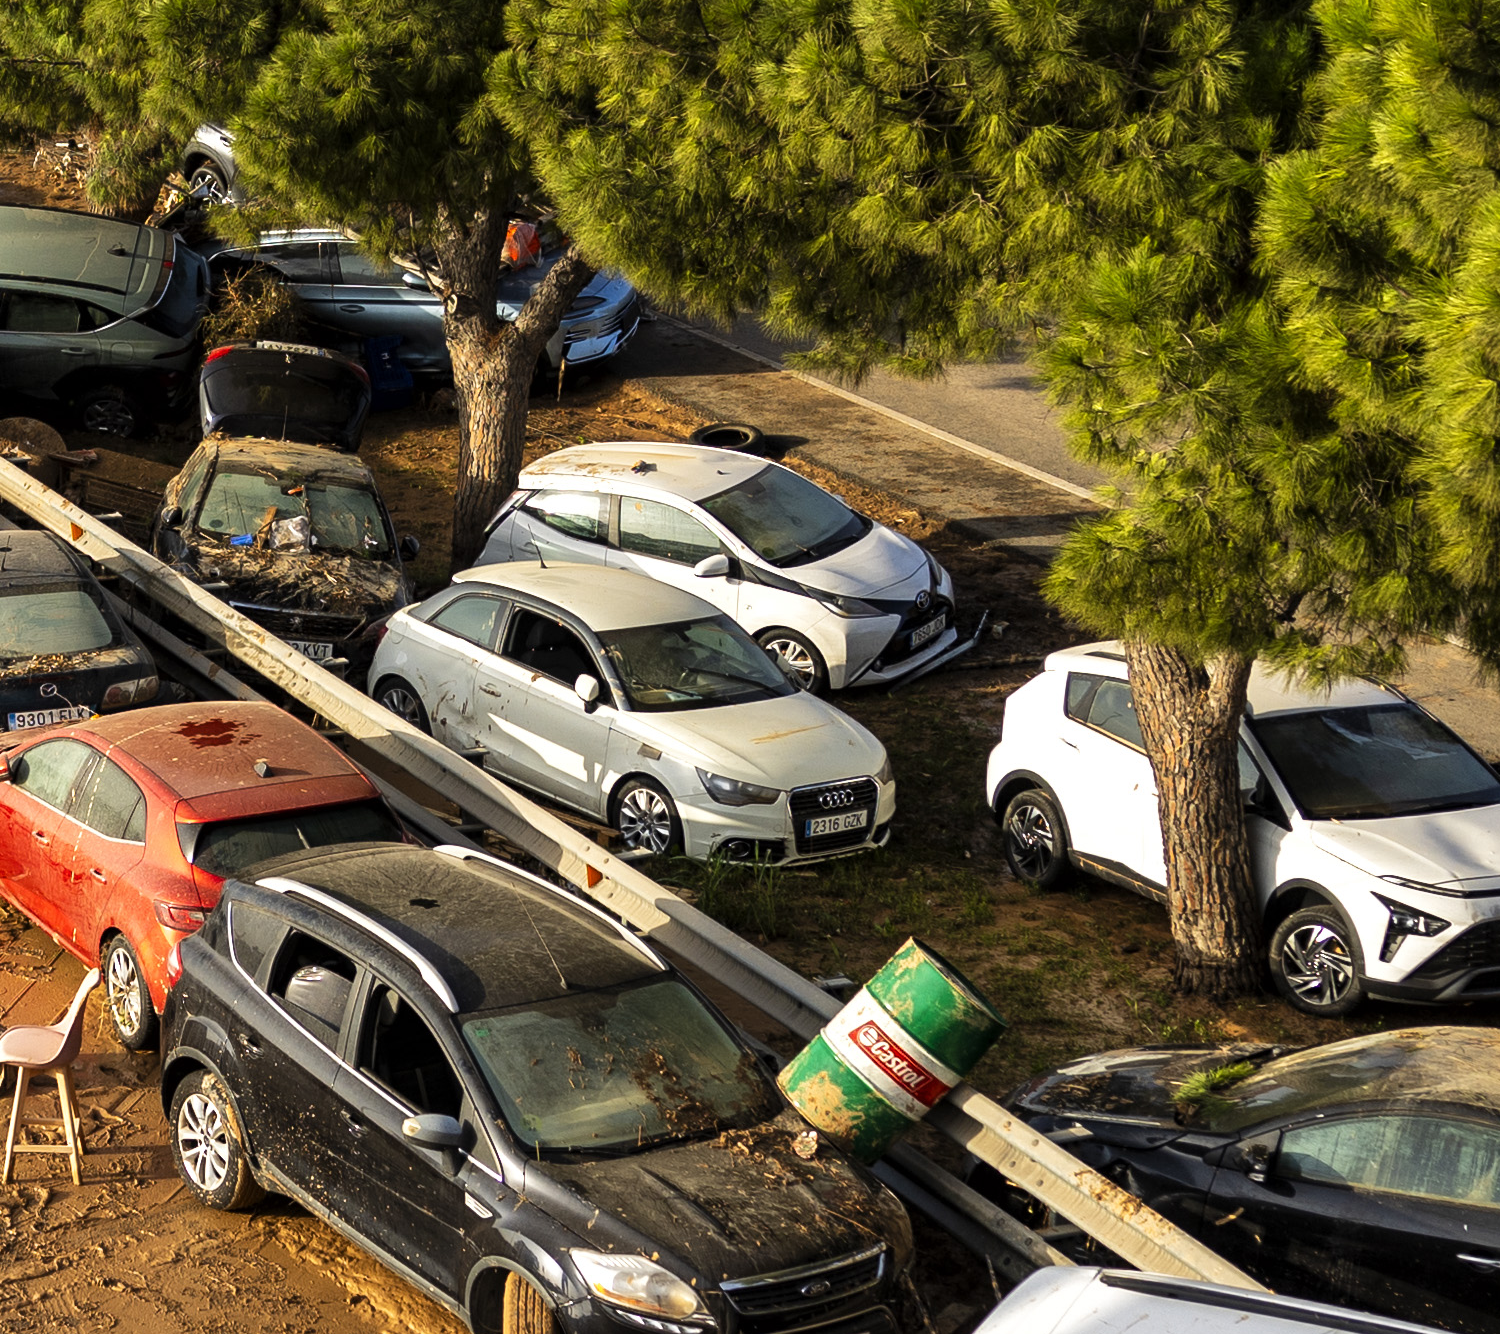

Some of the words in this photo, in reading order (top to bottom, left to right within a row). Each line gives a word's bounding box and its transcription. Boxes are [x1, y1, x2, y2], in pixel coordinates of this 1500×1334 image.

[16, 710, 54, 727] 9301
[813, 818, 840, 834] 2316
[844, 813, 863, 828] GZK
[871, 1040, 926, 1089] Castrol
